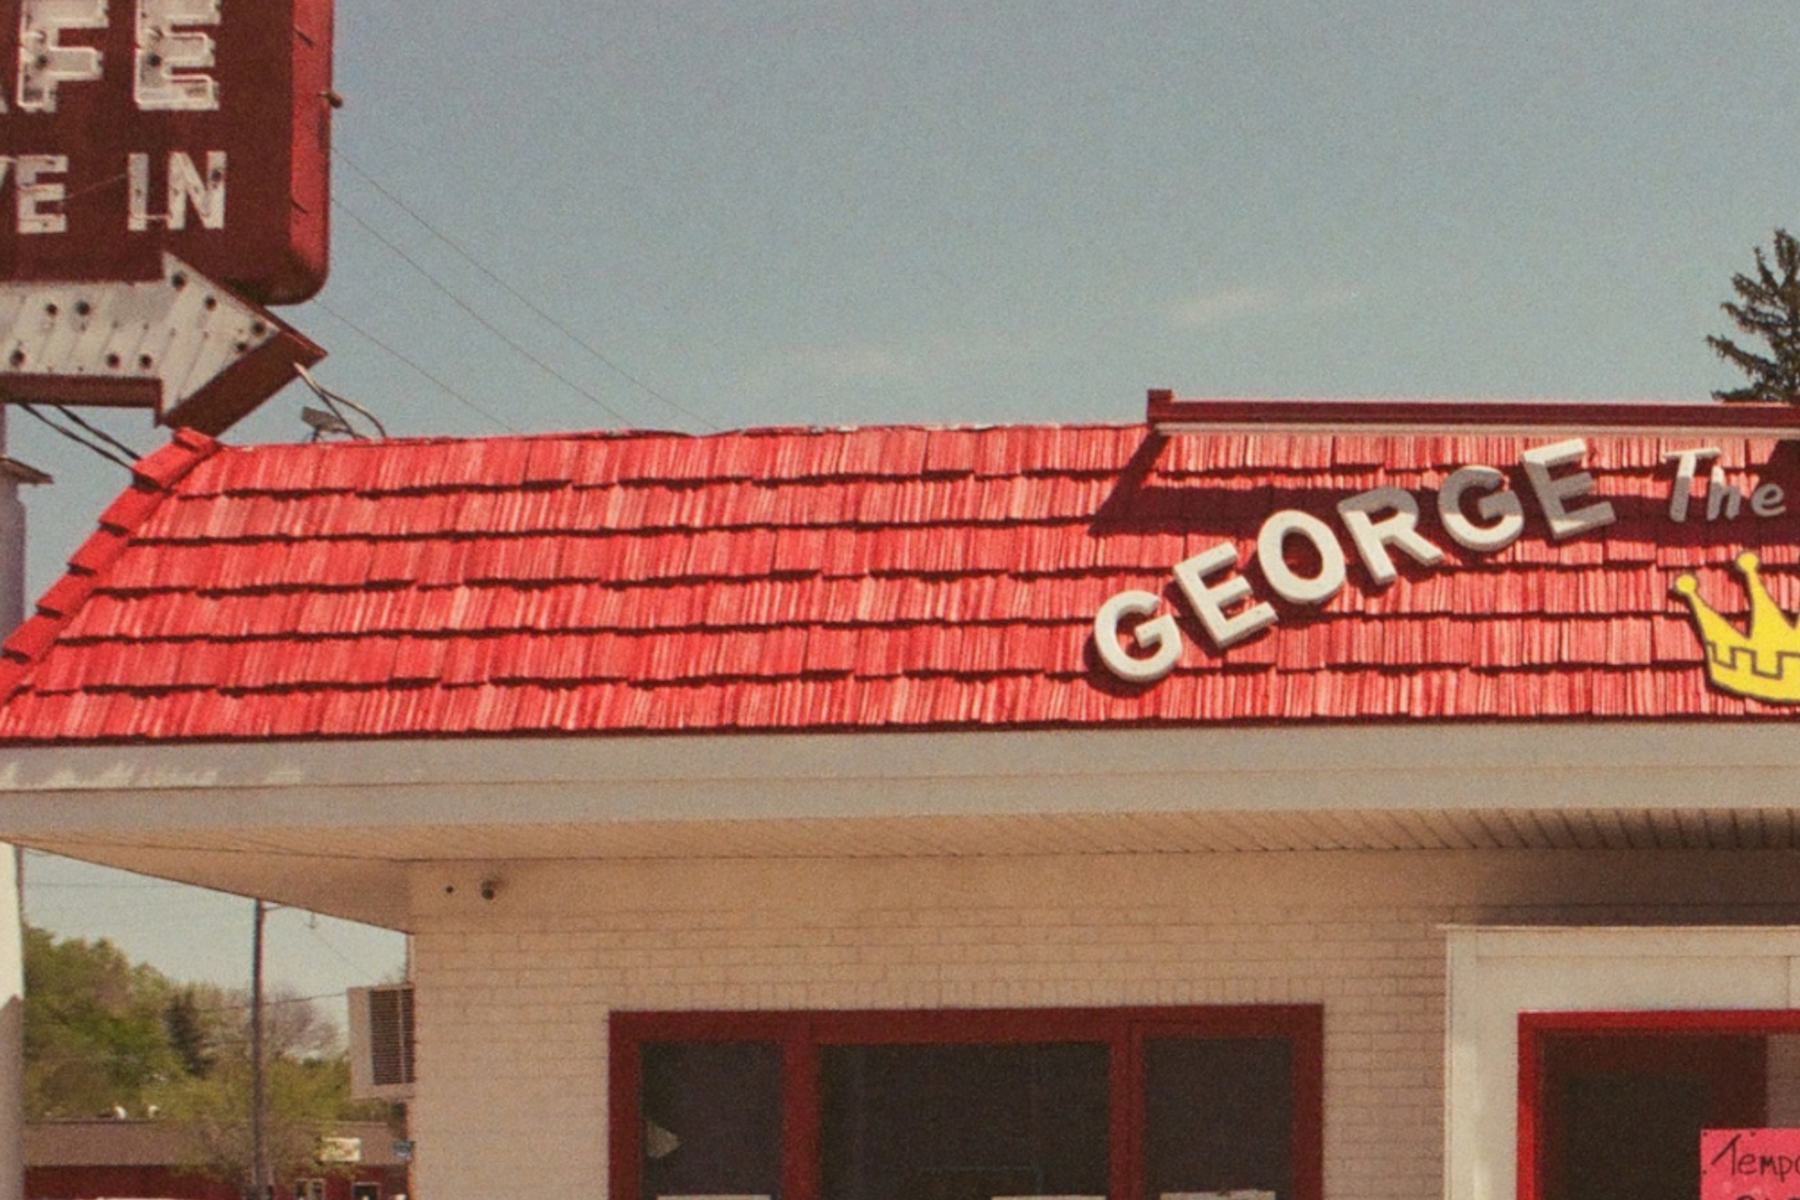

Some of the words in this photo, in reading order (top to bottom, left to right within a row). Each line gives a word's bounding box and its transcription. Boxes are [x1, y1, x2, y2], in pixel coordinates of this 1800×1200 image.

[0, 0, 222, 113] FE
[0, 153, 69, 234] E
[127, 150, 227, 232] IN
[1093, 438, 1617, 683] GEORGE
[1661, 446, 1788, 523] The
